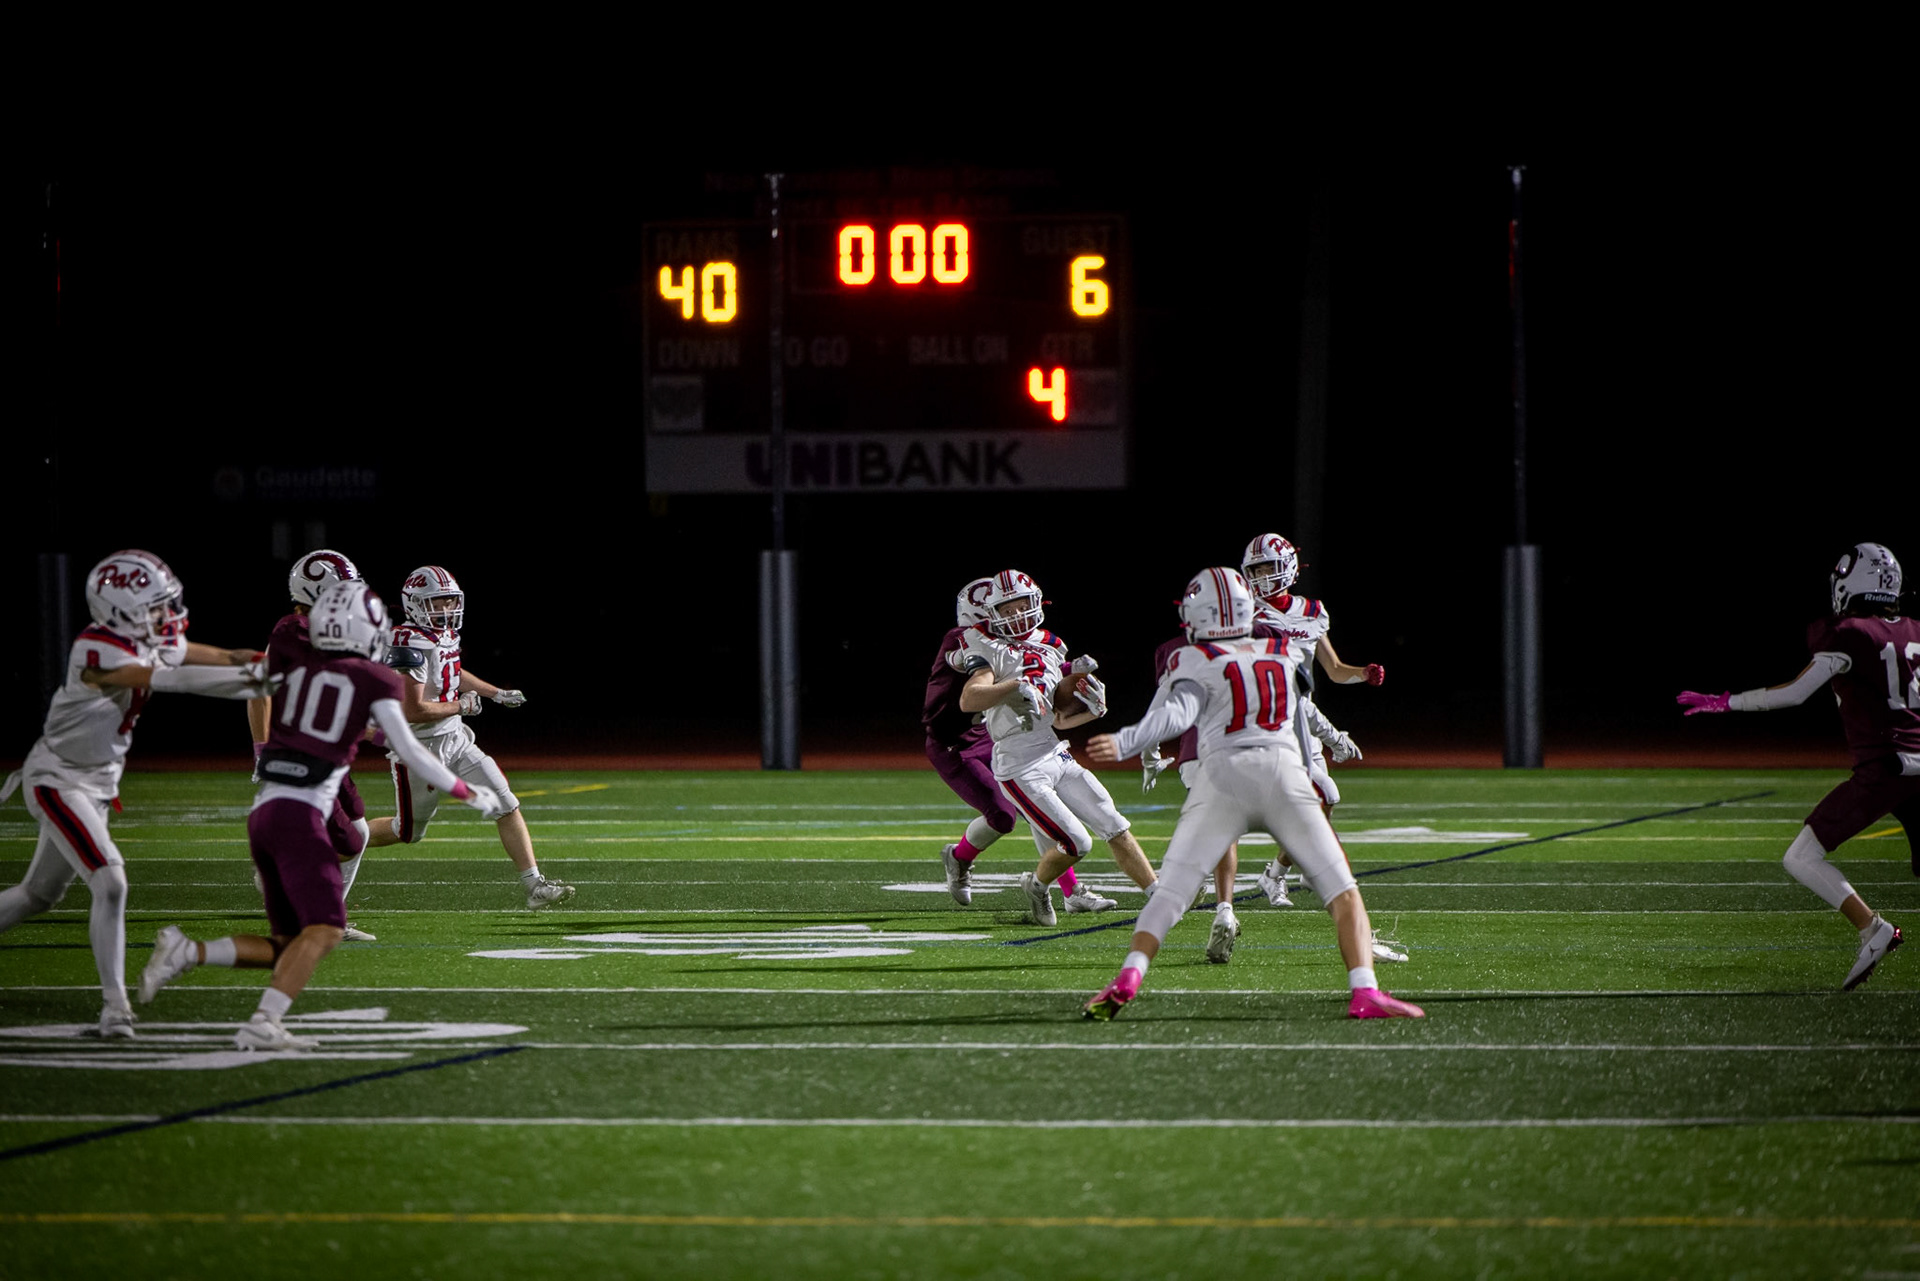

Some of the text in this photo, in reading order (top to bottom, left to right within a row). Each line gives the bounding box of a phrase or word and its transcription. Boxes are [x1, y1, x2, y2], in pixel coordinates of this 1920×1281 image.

[656, 259, 740, 324] 40
[1069, 253, 1112, 318] 6
[657, 338, 741, 369] DOWN
[1026, 365, 1068, 423] 4
[255, 465, 377, 488] Gaudette
[745, 440, 1023, 486] UNIBANK
[96, 564, 151, 595] Pats
[1864, 593, 1897, 604] Riddell
[279, 666, 356, 743] 10
[1223, 659, 1289, 735] 10
